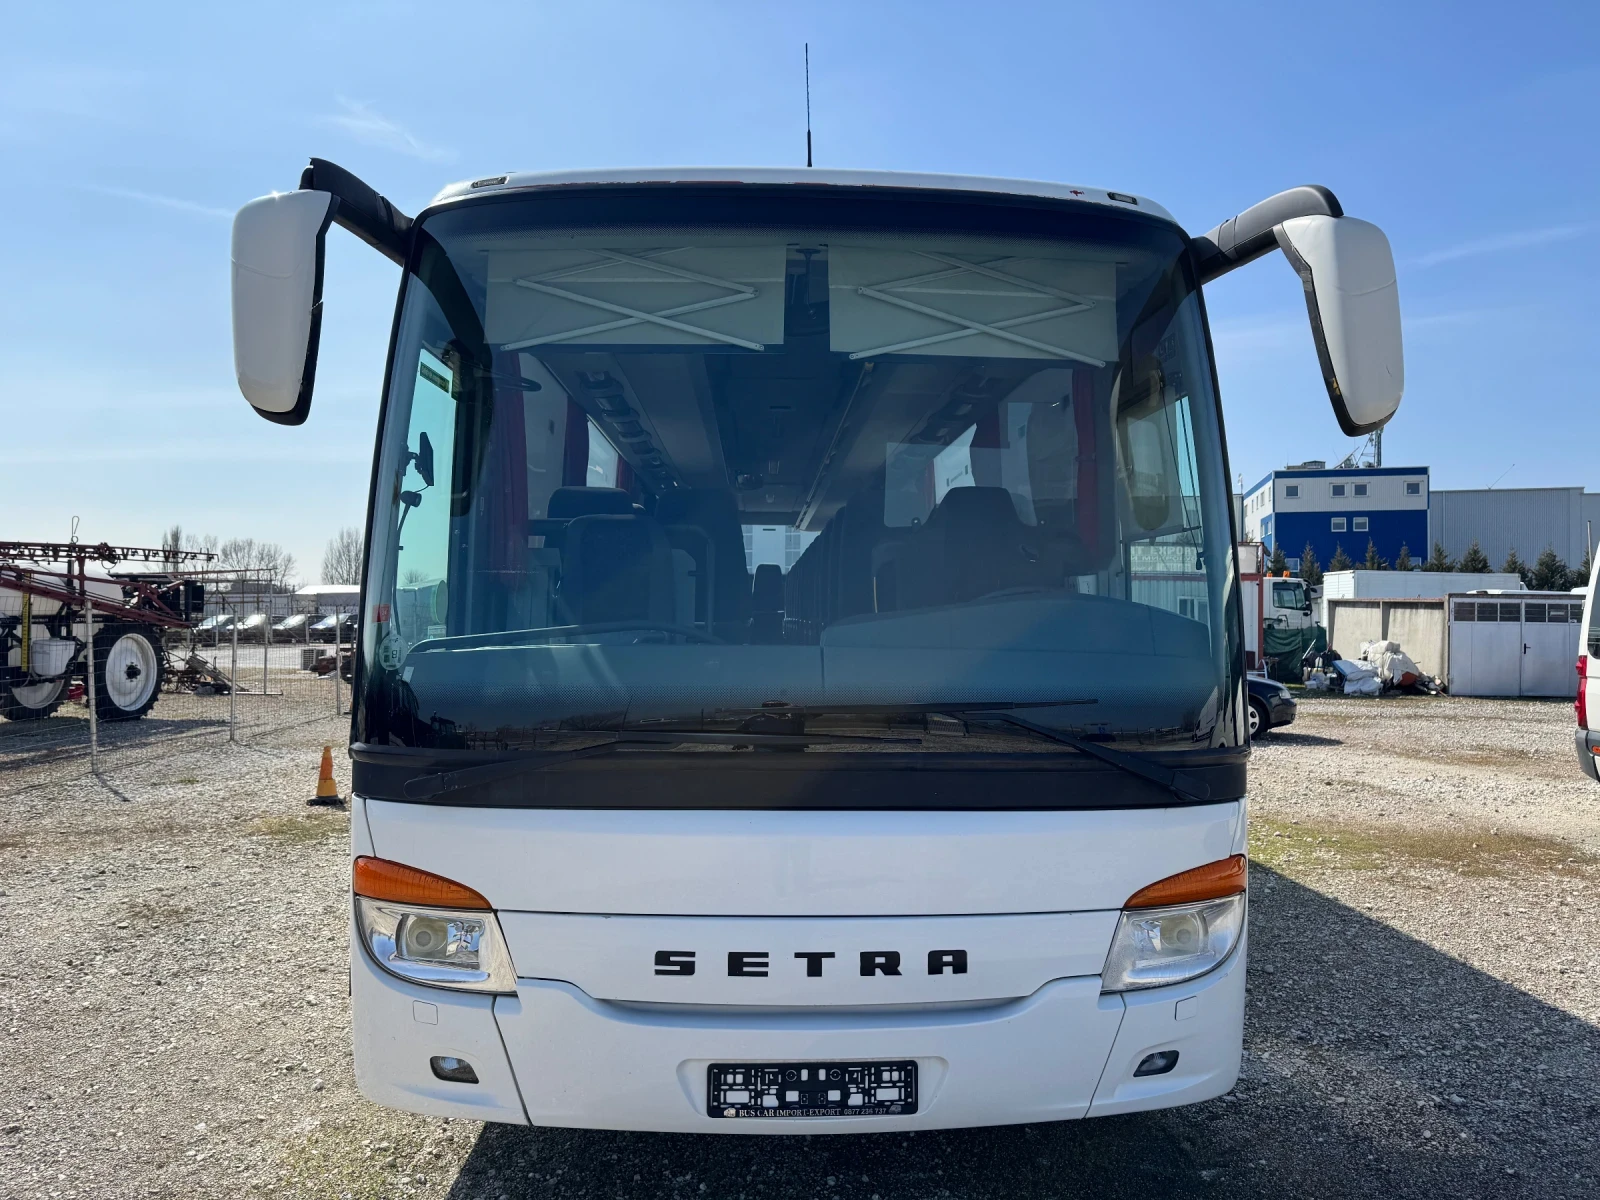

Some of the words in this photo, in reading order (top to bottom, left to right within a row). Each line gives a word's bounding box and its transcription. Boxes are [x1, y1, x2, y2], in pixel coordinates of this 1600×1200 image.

[654, 949, 968, 977] SETRA
[739, 1109, 756, 1117] BUS
[757, 1109, 774, 1117] CAR
[776, 1108, 841, 1117] IMPORT-EXPORT
